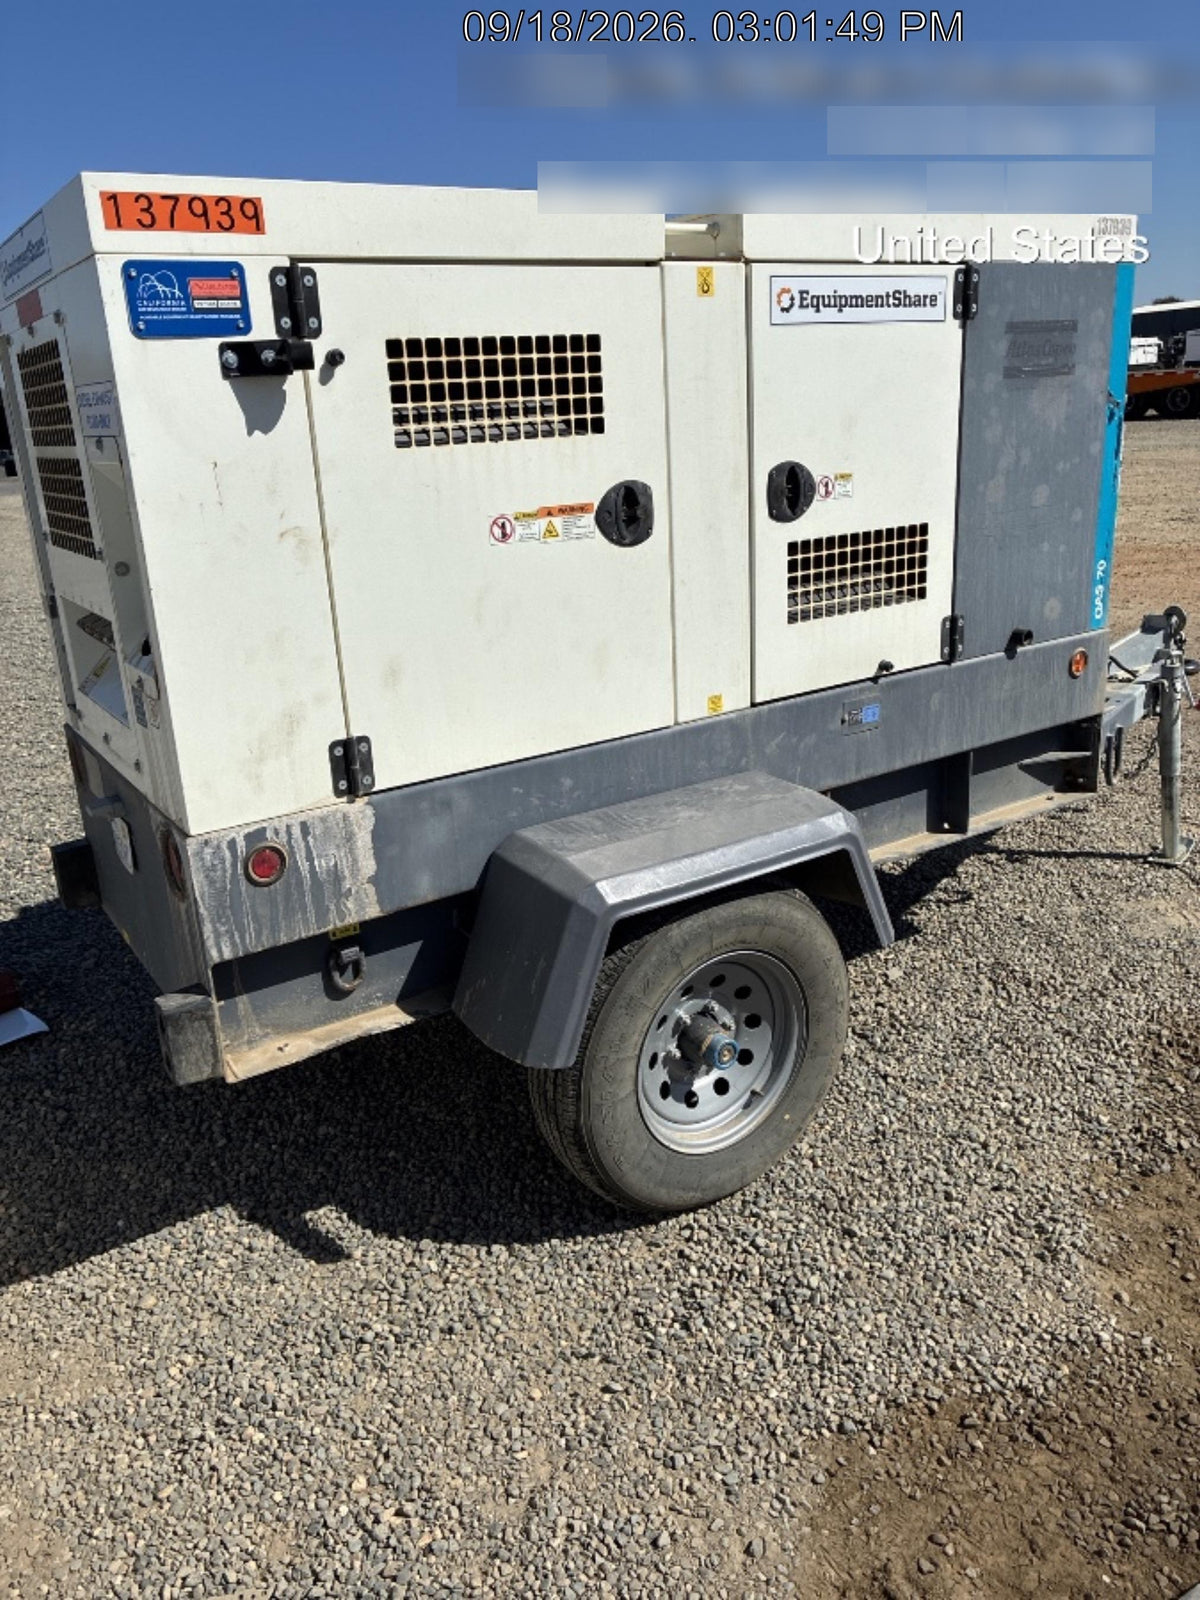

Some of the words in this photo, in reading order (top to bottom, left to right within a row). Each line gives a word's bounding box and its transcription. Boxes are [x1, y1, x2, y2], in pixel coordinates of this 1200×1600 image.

[106, 193, 262, 232] 137939
[797, 289, 938, 313] EquipmentShare
[1096, 559, 1107, 580] 70
